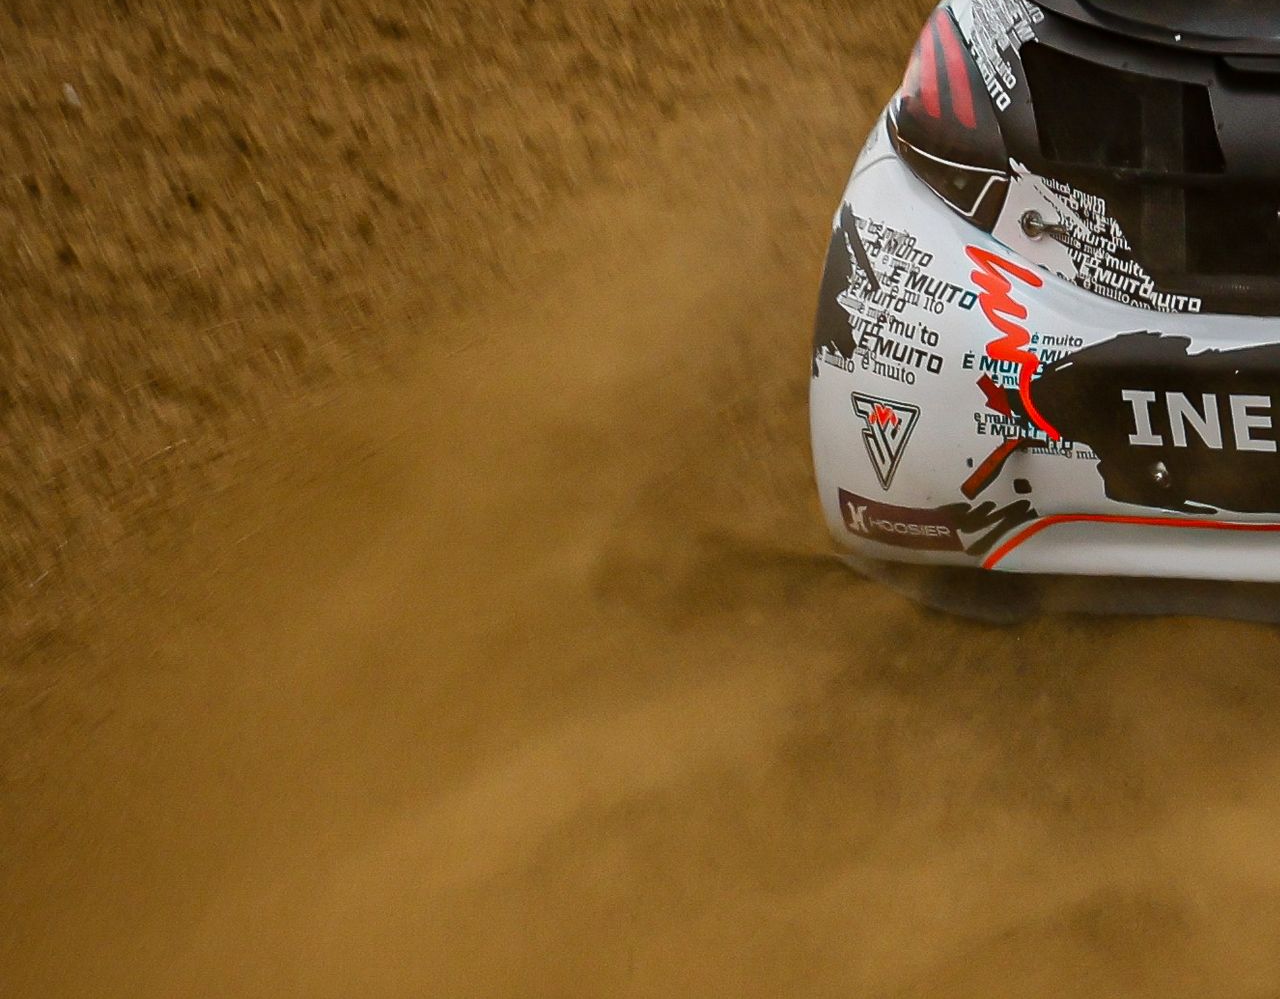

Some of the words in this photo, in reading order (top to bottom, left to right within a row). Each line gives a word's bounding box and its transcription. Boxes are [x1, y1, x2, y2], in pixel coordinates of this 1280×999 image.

[1042, 333, 1084, 348] muito
[874, 336, 944, 375] MUITO
[962, 350, 975, 370] É
